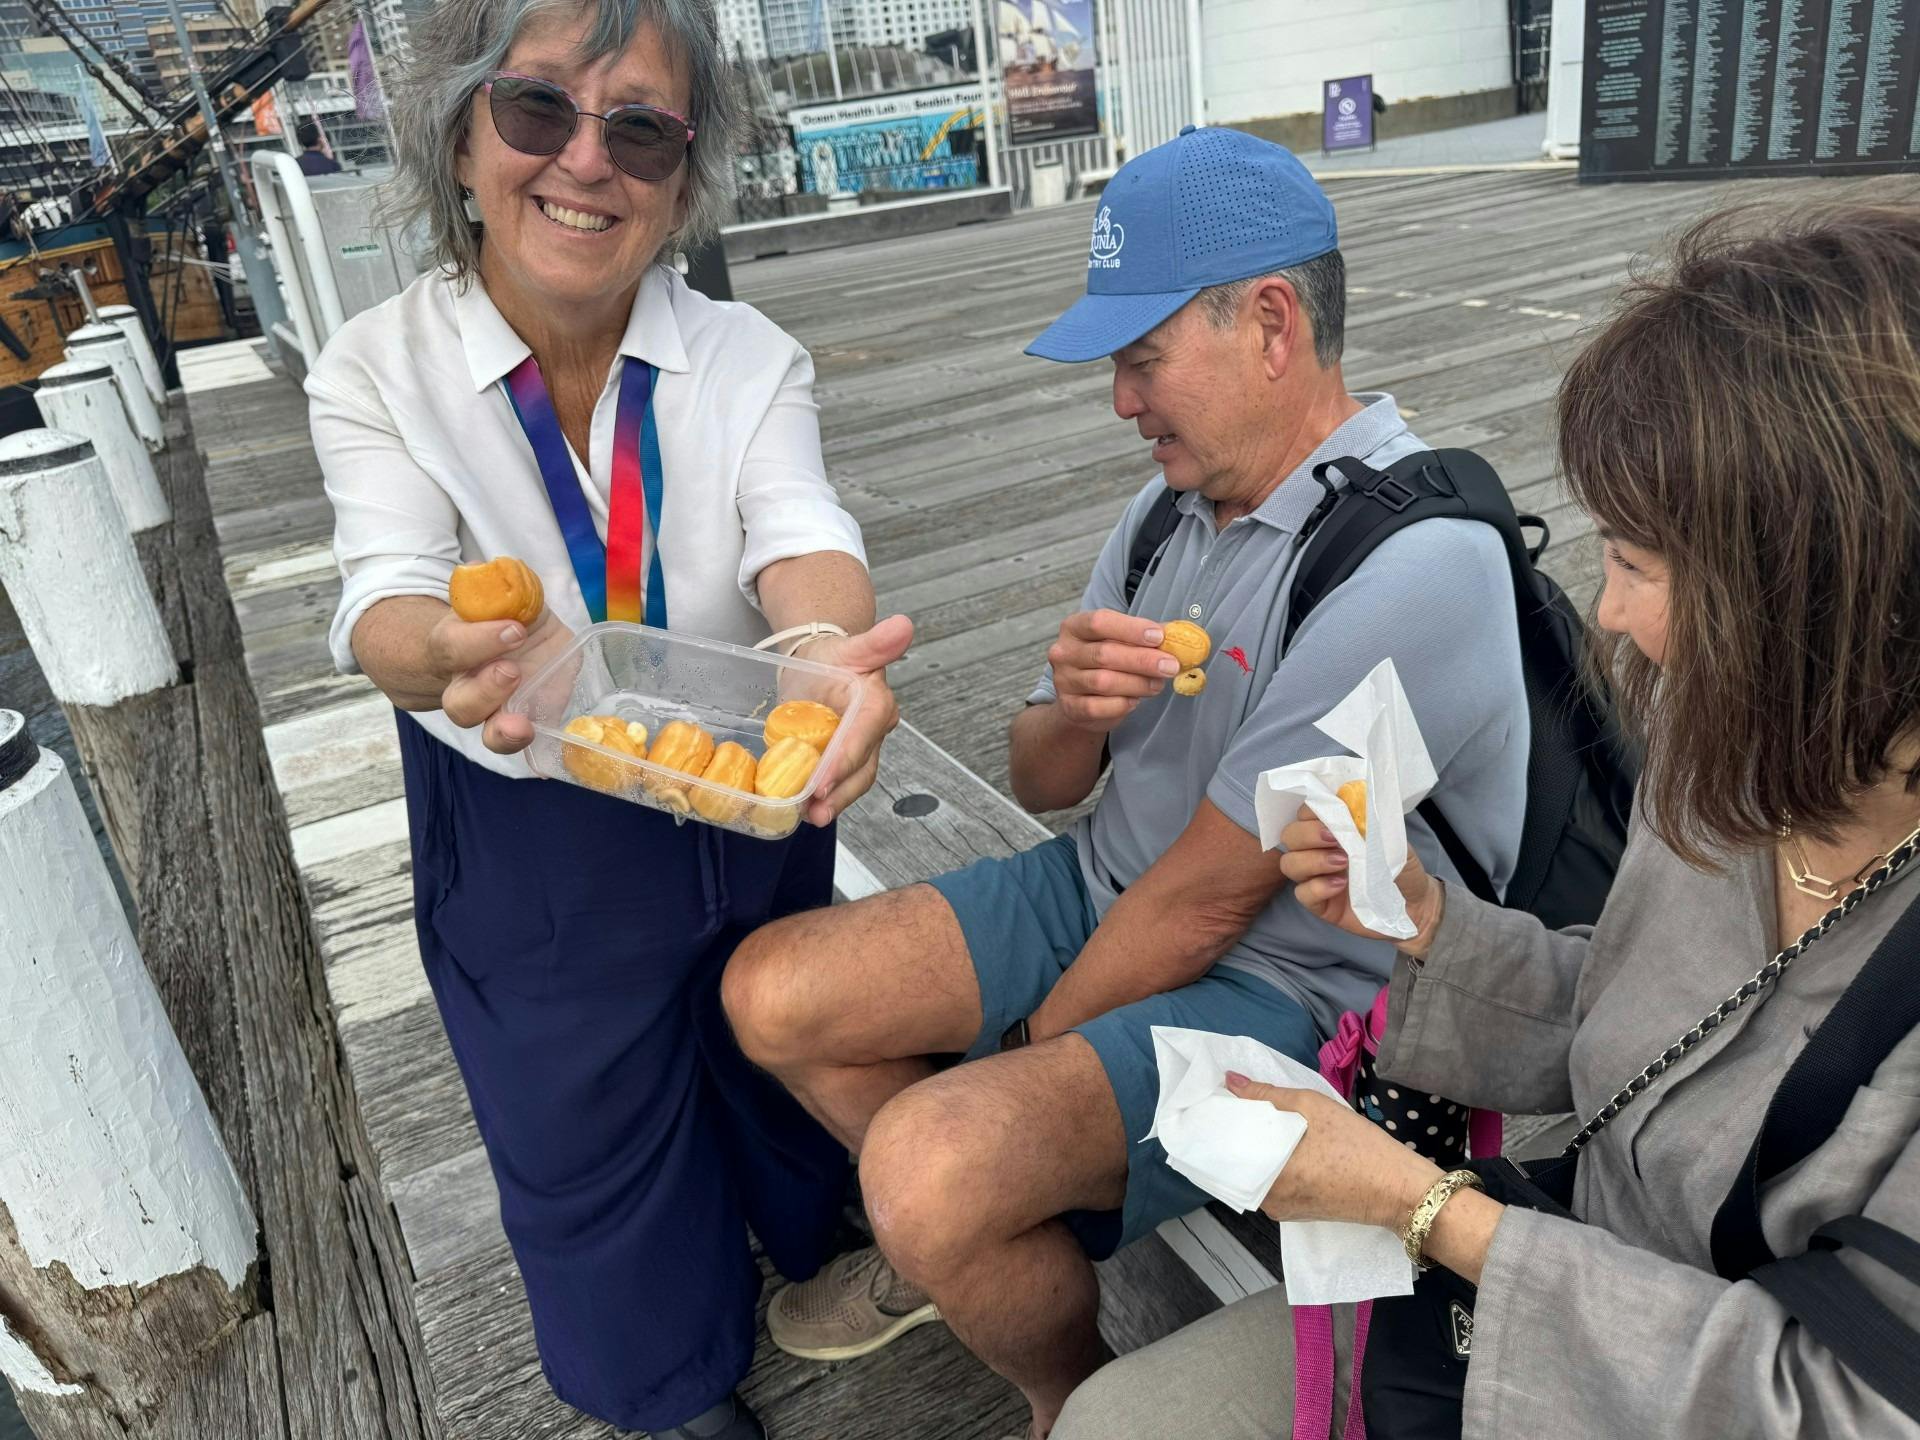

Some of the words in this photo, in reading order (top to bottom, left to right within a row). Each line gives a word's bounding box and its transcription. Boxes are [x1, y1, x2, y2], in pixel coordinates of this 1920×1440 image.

[802, 112, 836, 125] Ocean
[837, 105, 874, 120] Health
[876, 103, 897, 115] Lab
[1103, 259, 1120, 268] CLUB
